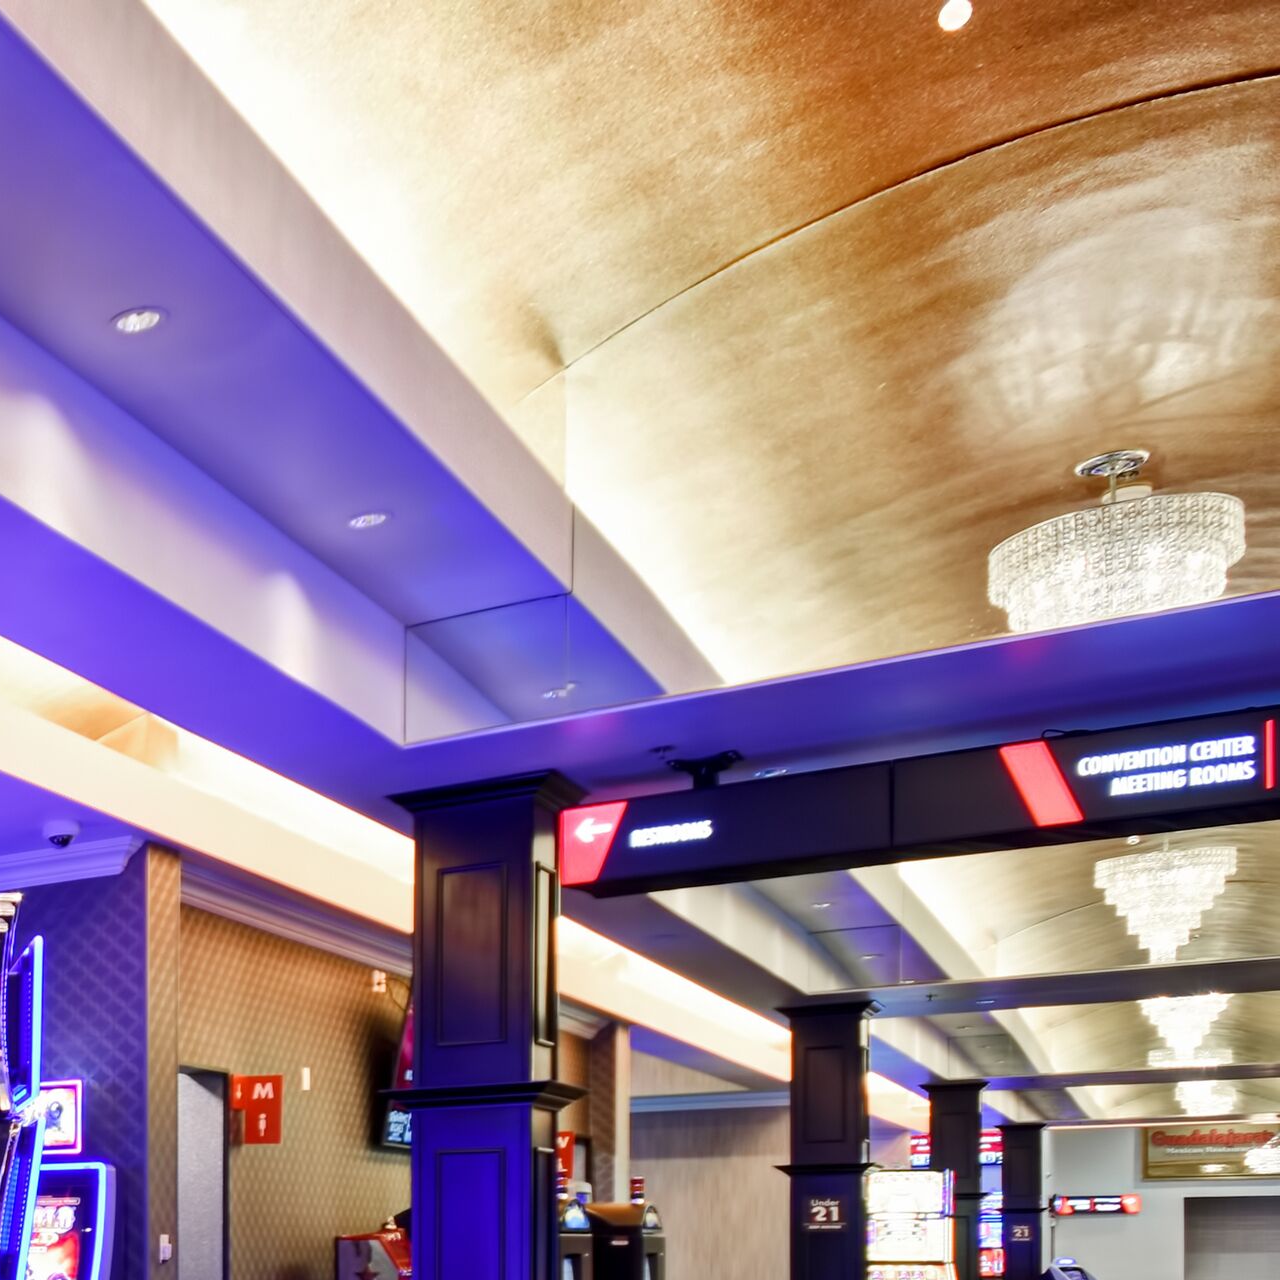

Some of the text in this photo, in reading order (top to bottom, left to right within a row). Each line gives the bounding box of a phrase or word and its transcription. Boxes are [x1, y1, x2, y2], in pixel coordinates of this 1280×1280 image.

[1077, 735, 1256, 777] CONVENTION CENTER
[1109, 760, 1257, 797] MEETING ROOMS
[252, 1082, 274, 1100] M
[811, 1206, 839, 1221] 21
[1013, 1228, 1029, 1237] 21
